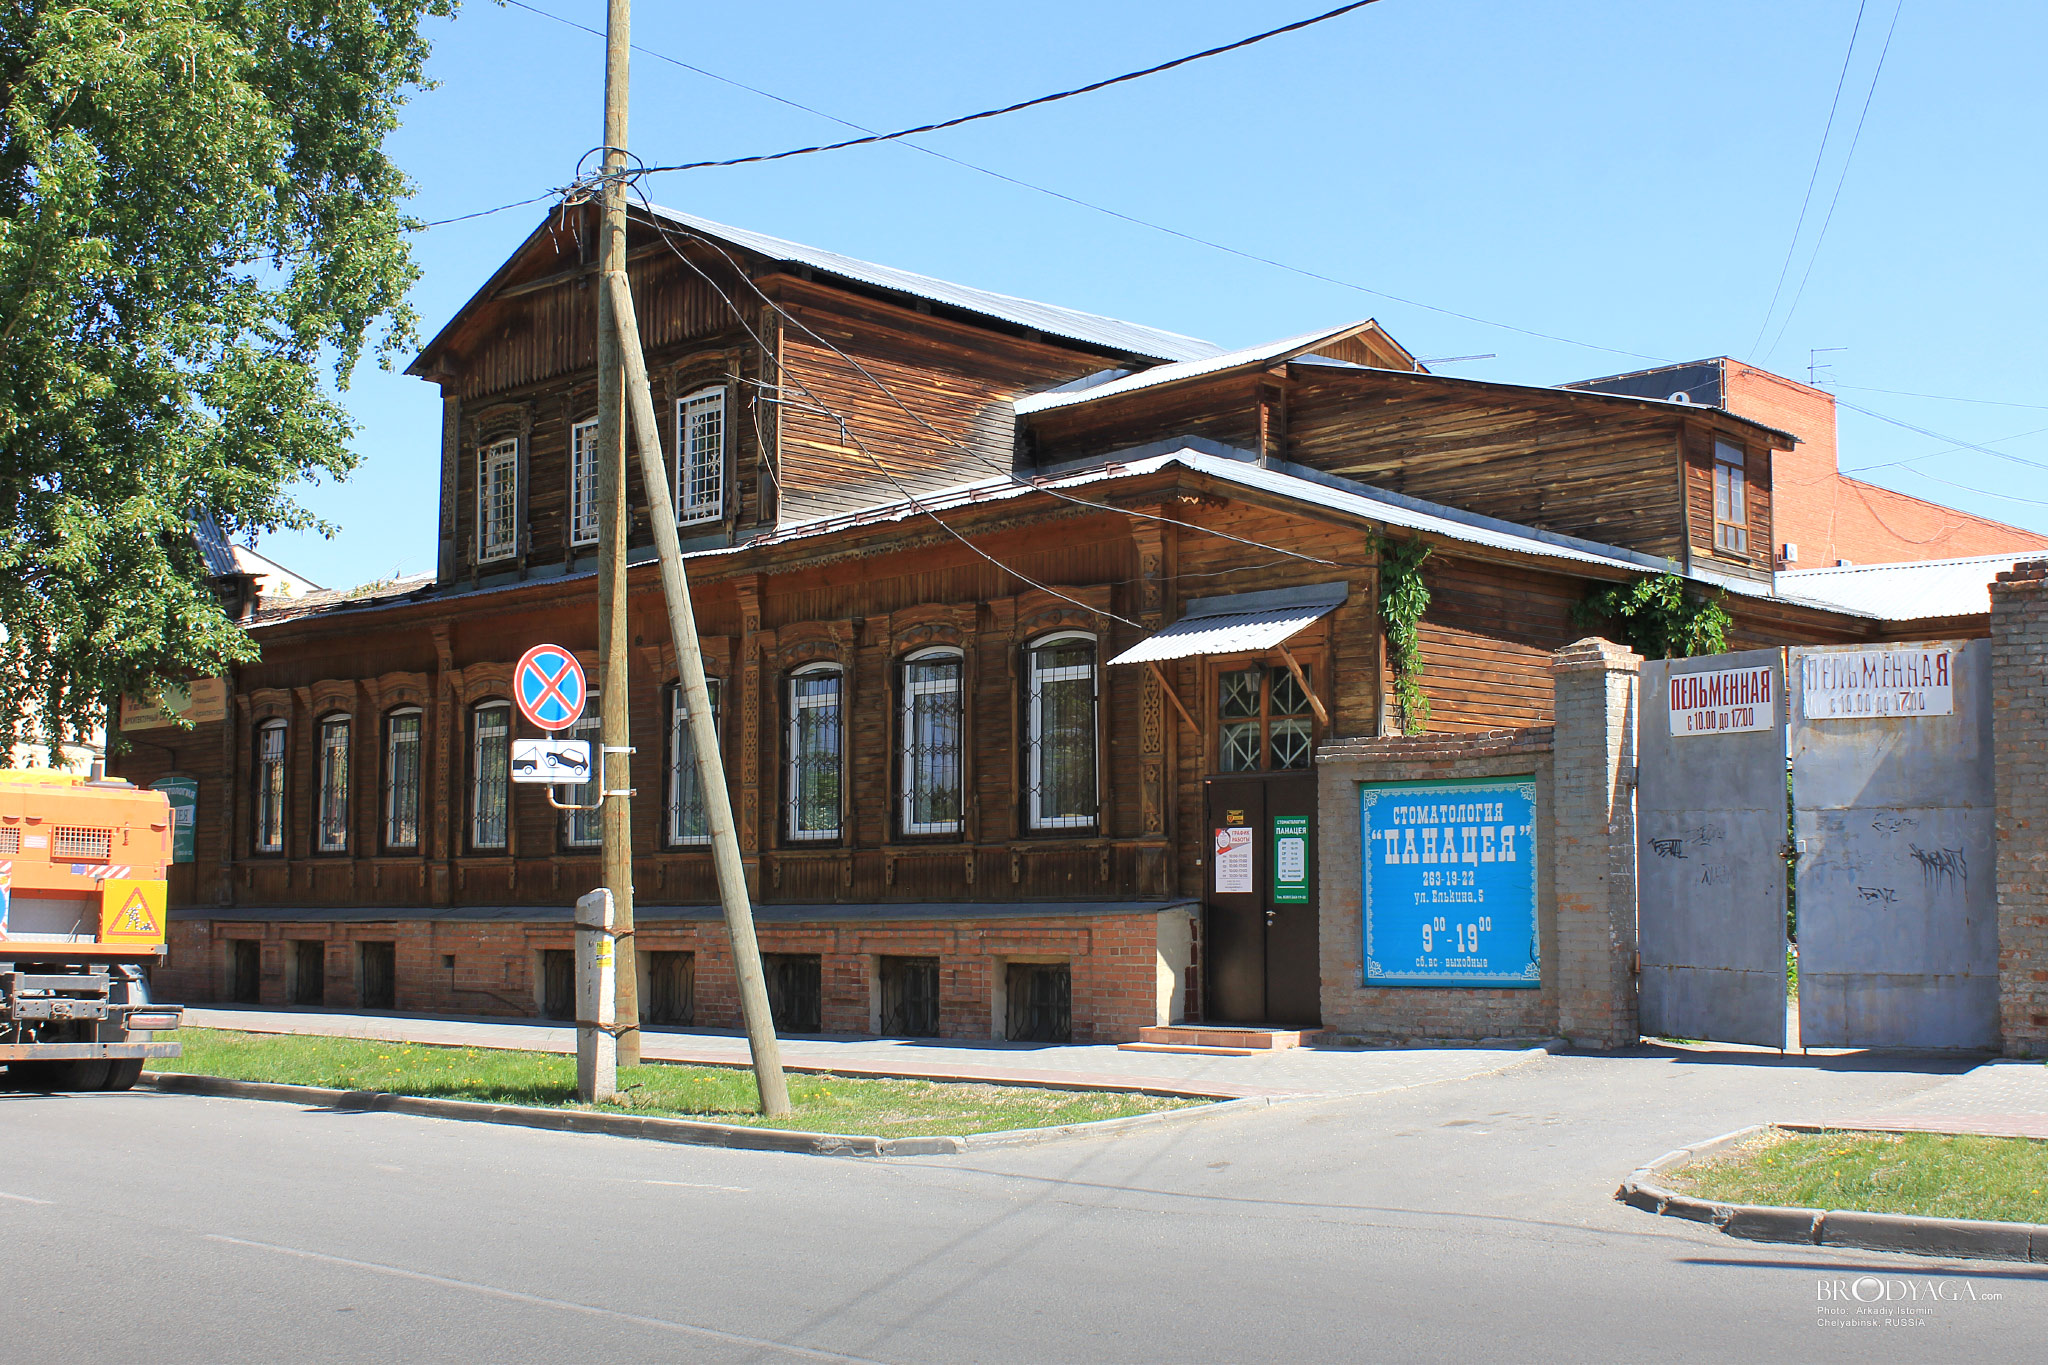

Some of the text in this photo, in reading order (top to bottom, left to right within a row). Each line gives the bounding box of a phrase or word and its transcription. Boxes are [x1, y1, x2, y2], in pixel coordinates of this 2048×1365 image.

[1671, 670, 1770, 710] ПЕЛЬМЕННАЯ
[1687, 707, 1754, 731] с 10.00 до 17.00
[1393, 803, 1503, 825] СТОМАТОЛОГИЯ
[1276, 827, 1306, 835] ПАНАЦЕЯ
[1422, 871, 1475, 886] 263-19-22
[1414, 892, 1429, 905] ул.
[1446, 956, 1488, 968] выходные
